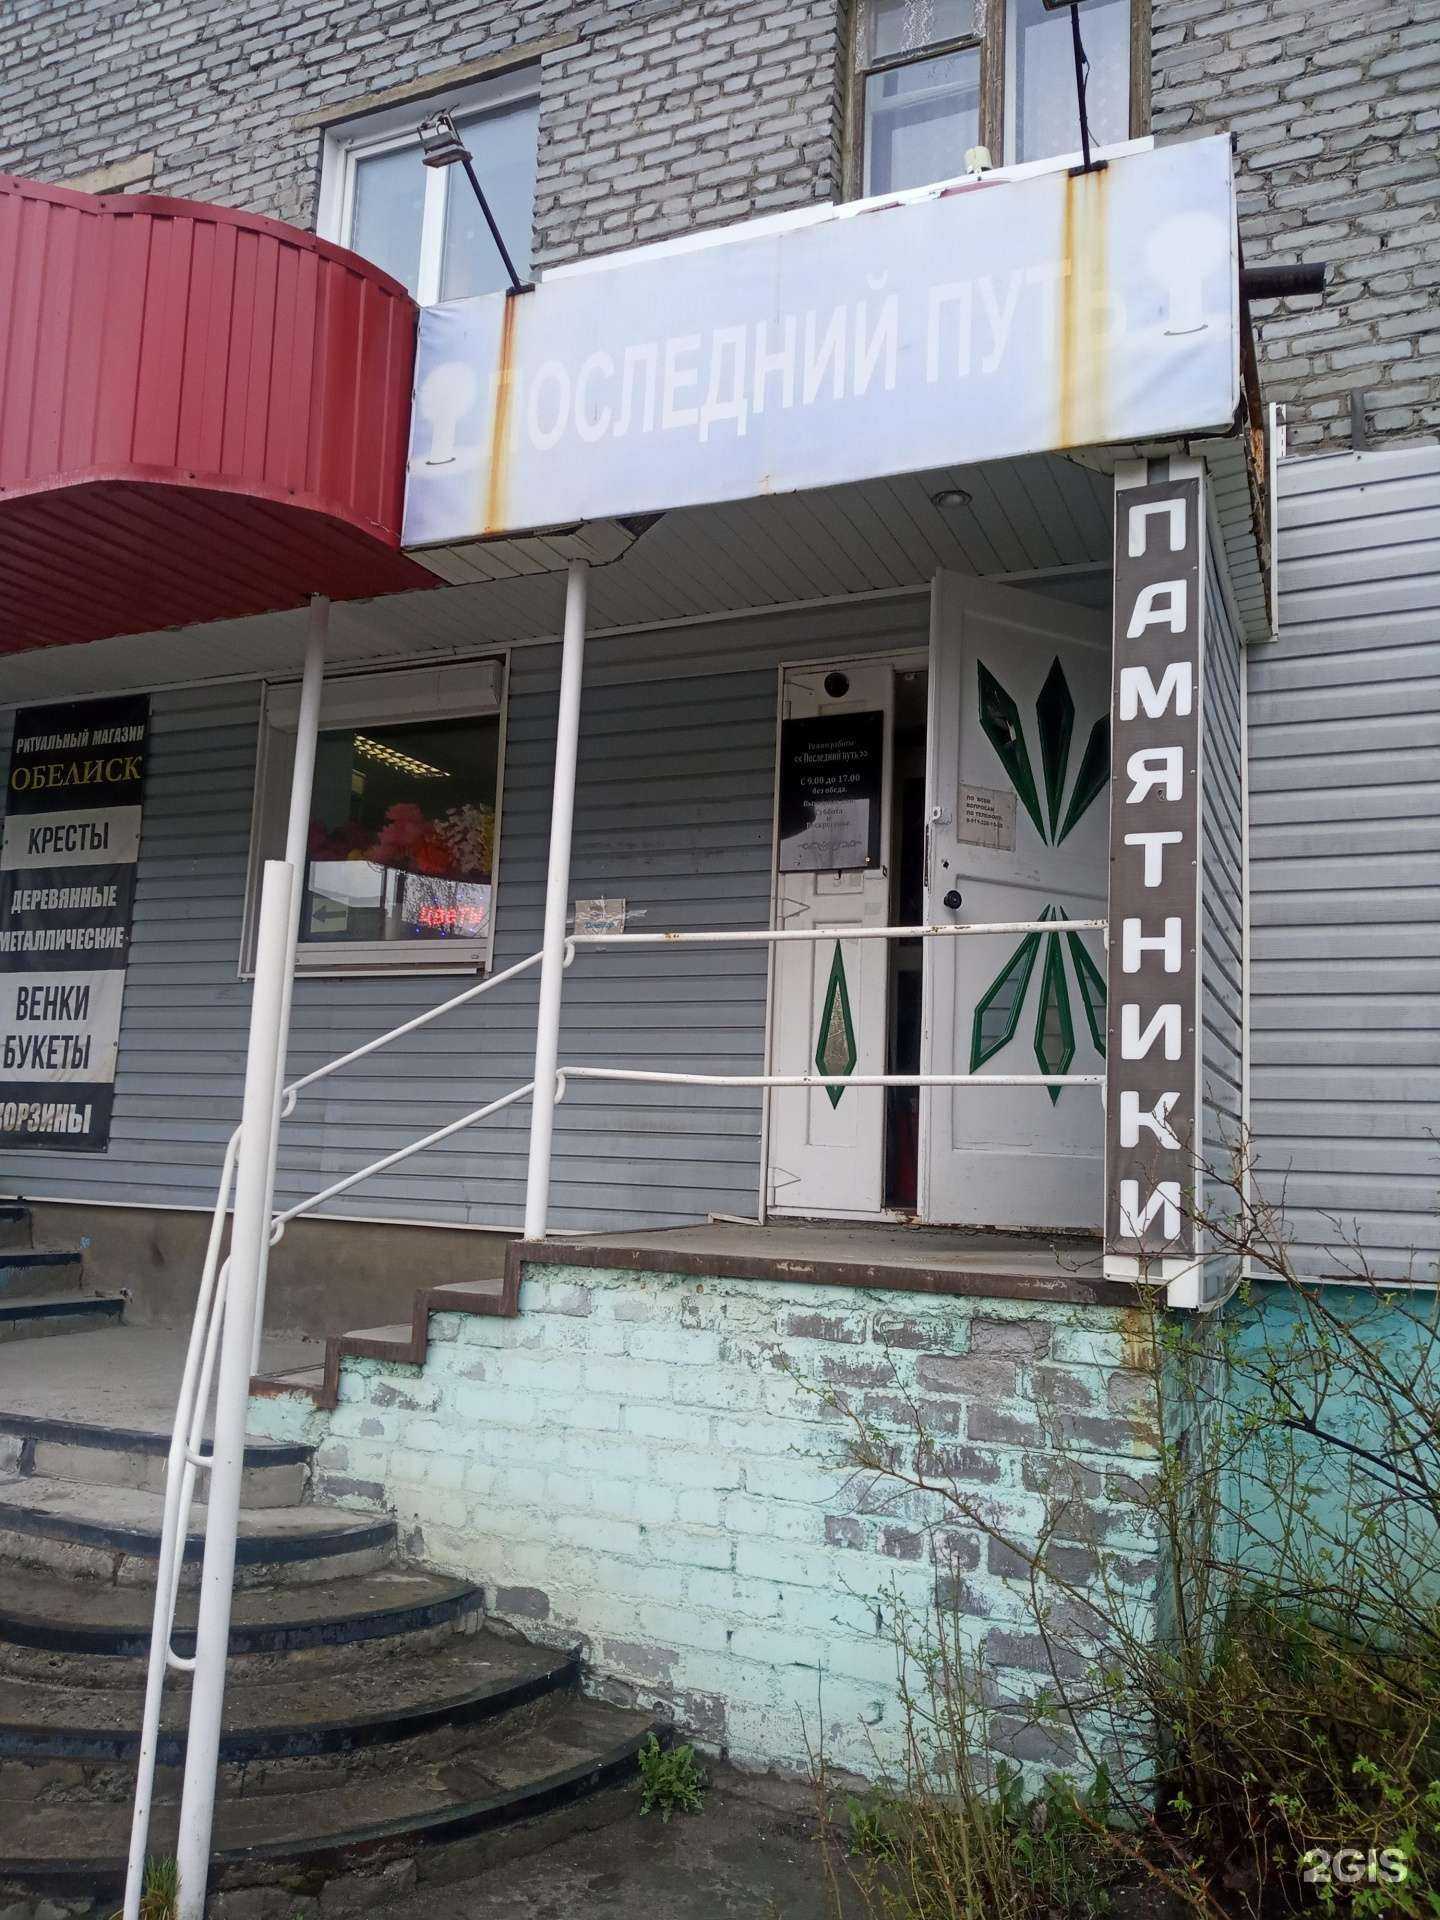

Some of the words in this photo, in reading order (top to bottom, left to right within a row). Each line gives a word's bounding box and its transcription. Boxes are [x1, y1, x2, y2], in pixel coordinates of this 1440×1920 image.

[488, 269, 900, 457] ПОСЛЕДНИЙ
[16, 729, 89, 753] РИТУАЛЬНЫЙ
[92, 725, 144, 746] МАГАЗИН
[11, 756, 143, 791] ОБЕЛИСК
[825, 776, 836, 785] до
[838, 774, 861, 784] 17.00
[28, 822, 109, 855] КРЕСТЫ
[1119, 497, 1192, 1239] ПАМЯТНИКИ
[11, 886, 118, 914] ДЕРЕВЯННЫЕ
[0, 927, 125, 952] МЕТАЛЛИЧЕСКИЕ
[16, 985, 90, 1020] ВЕНКИ
[3, 1035, 91, 1069] БУКЕТЫ
